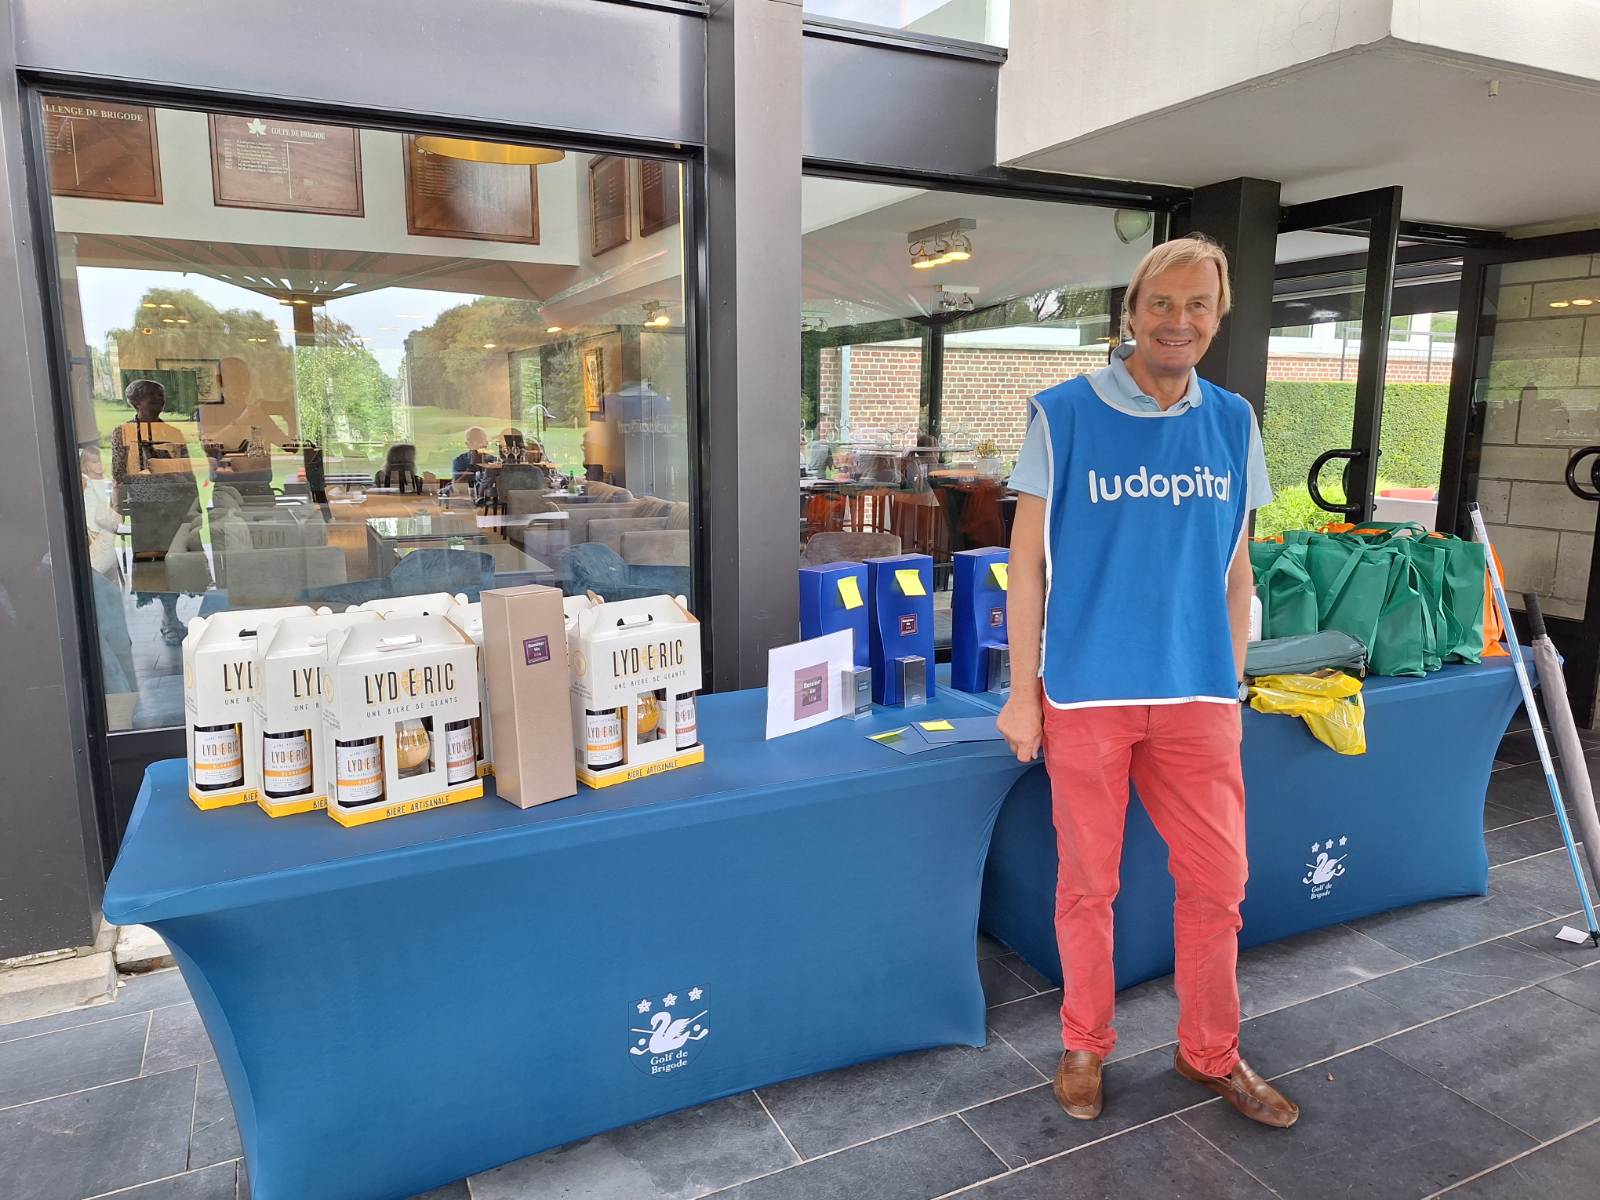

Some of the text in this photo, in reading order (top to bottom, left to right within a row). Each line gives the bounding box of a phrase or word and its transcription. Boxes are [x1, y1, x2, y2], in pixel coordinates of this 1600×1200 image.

[86, 108, 100, 117] DE
[101, 110, 143, 122] BRIGODE
[1088, 465, 1231, 506] ludopital
[1312, 884, 1325, 893] Golf
[650, 1050, 688, 1066] Golf de
[651, 1060, 688, 1074] Brigode
